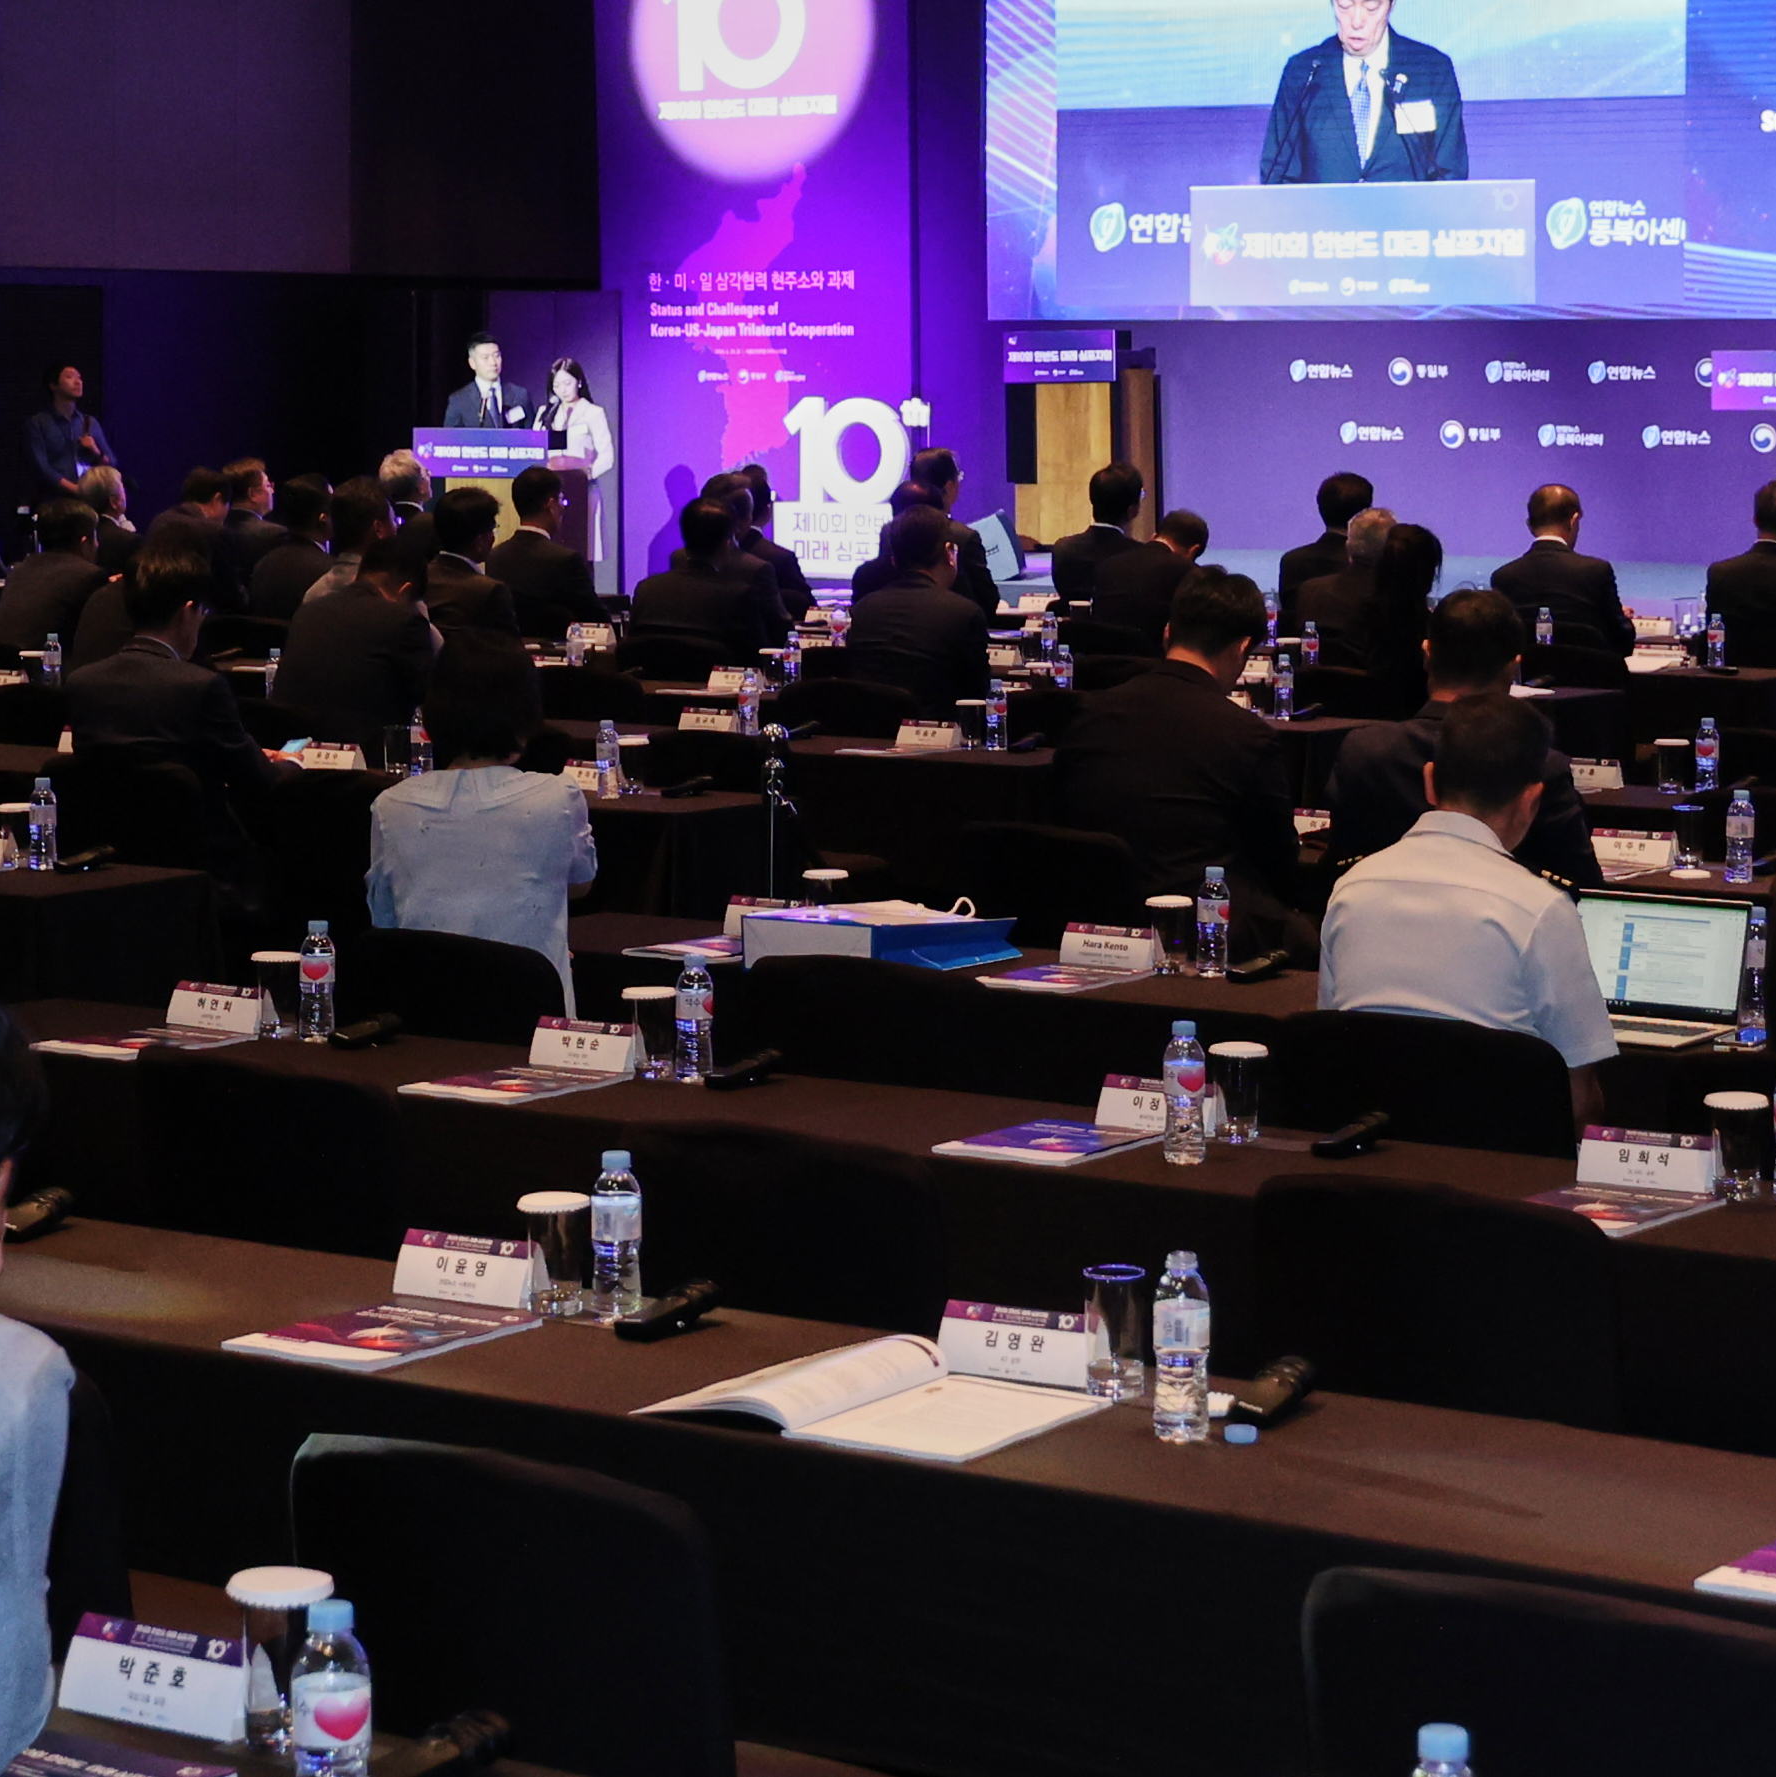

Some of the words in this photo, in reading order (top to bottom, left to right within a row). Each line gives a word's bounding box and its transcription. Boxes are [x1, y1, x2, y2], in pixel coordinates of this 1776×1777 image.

[1589, 200, 1647, 217] 연합뉴스
[1128, 212, 1191, 243] 연합
[1588, 217, 1687, 247] 동북아센
[716, 271, 768, 291] 삼각협력
[771, 270, 825, 291] 현주소와
[827, 269, 856, 290] 과제
[650, 302, 684, 317] Status
[685, 302, 705, 316] and
[707, 301, 766, 319] Challenges
[767, 301, 779, 316] of
[650, 322, 737, 340] Korea-US-Japan
[737, 322, 787, 337] Trilateral
[788, 322, 855, 340] Cooperation
[792, 512, 849, 535] 제10회
[793, 540, 830, 563] 미래
[1082, 938, 1103, 949] Hara
[1104, 940, 1130, 953] Kento
[984, 1329, 1046, 1354] 김영완
[119, 1655, 188, 1690] 박준호
